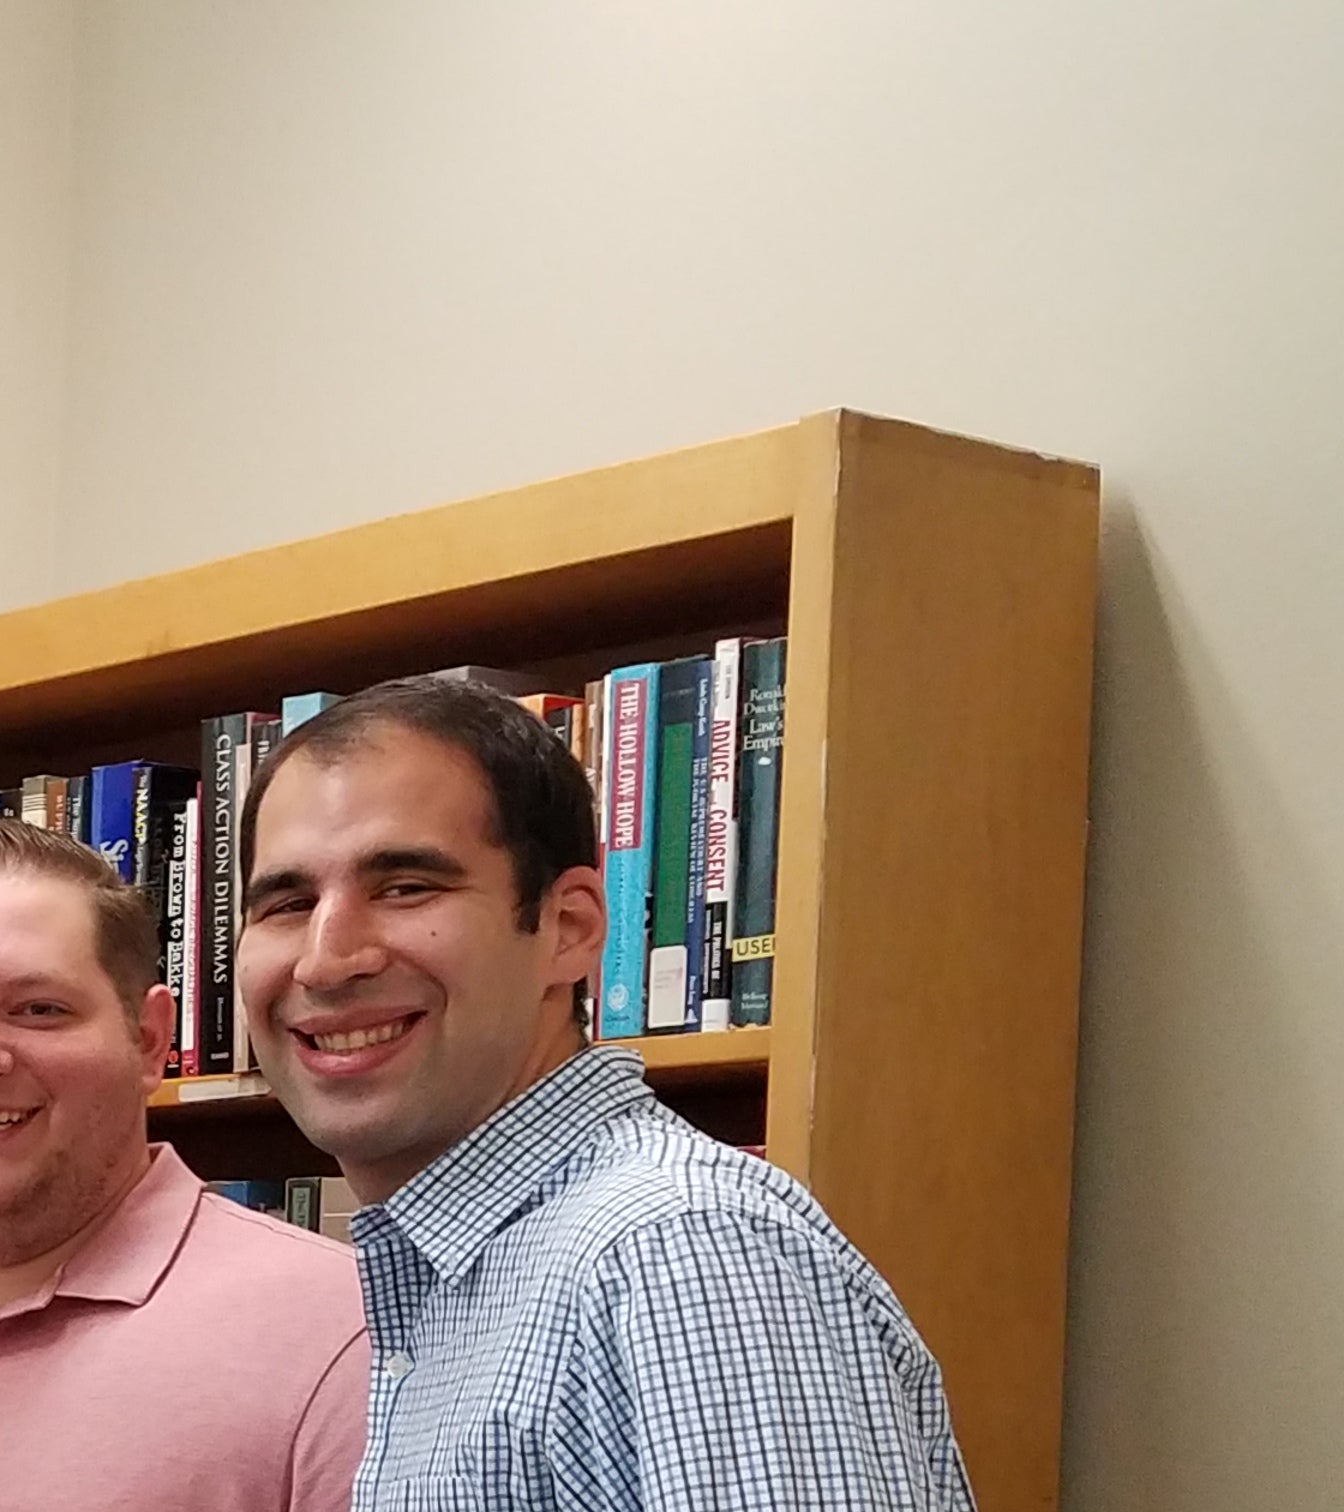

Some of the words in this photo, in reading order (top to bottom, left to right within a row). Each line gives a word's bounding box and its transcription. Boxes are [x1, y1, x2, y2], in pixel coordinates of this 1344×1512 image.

[619, 683, 640, 720] THE
[750, 685, 784, 701] Ronal
[214, 733, 232, 792] CLASS
[616, 724, 638, 797] HOLLOW
[710, 719, 732, 783] ADVICE
[172, 813, 186, 858] From
[214, 797, 231, 875] ACTION
[614, 801, 635, 849] HOPE
[706, 809, 727, 892] CONSENT
[99, 838, 129, 874] Si
[171, 859, 185, 917] Brown
[171, 918, 185, 939] to
[212, 880, 230, 984] DILEMMAS
[736, 937, 776, 957] USE
